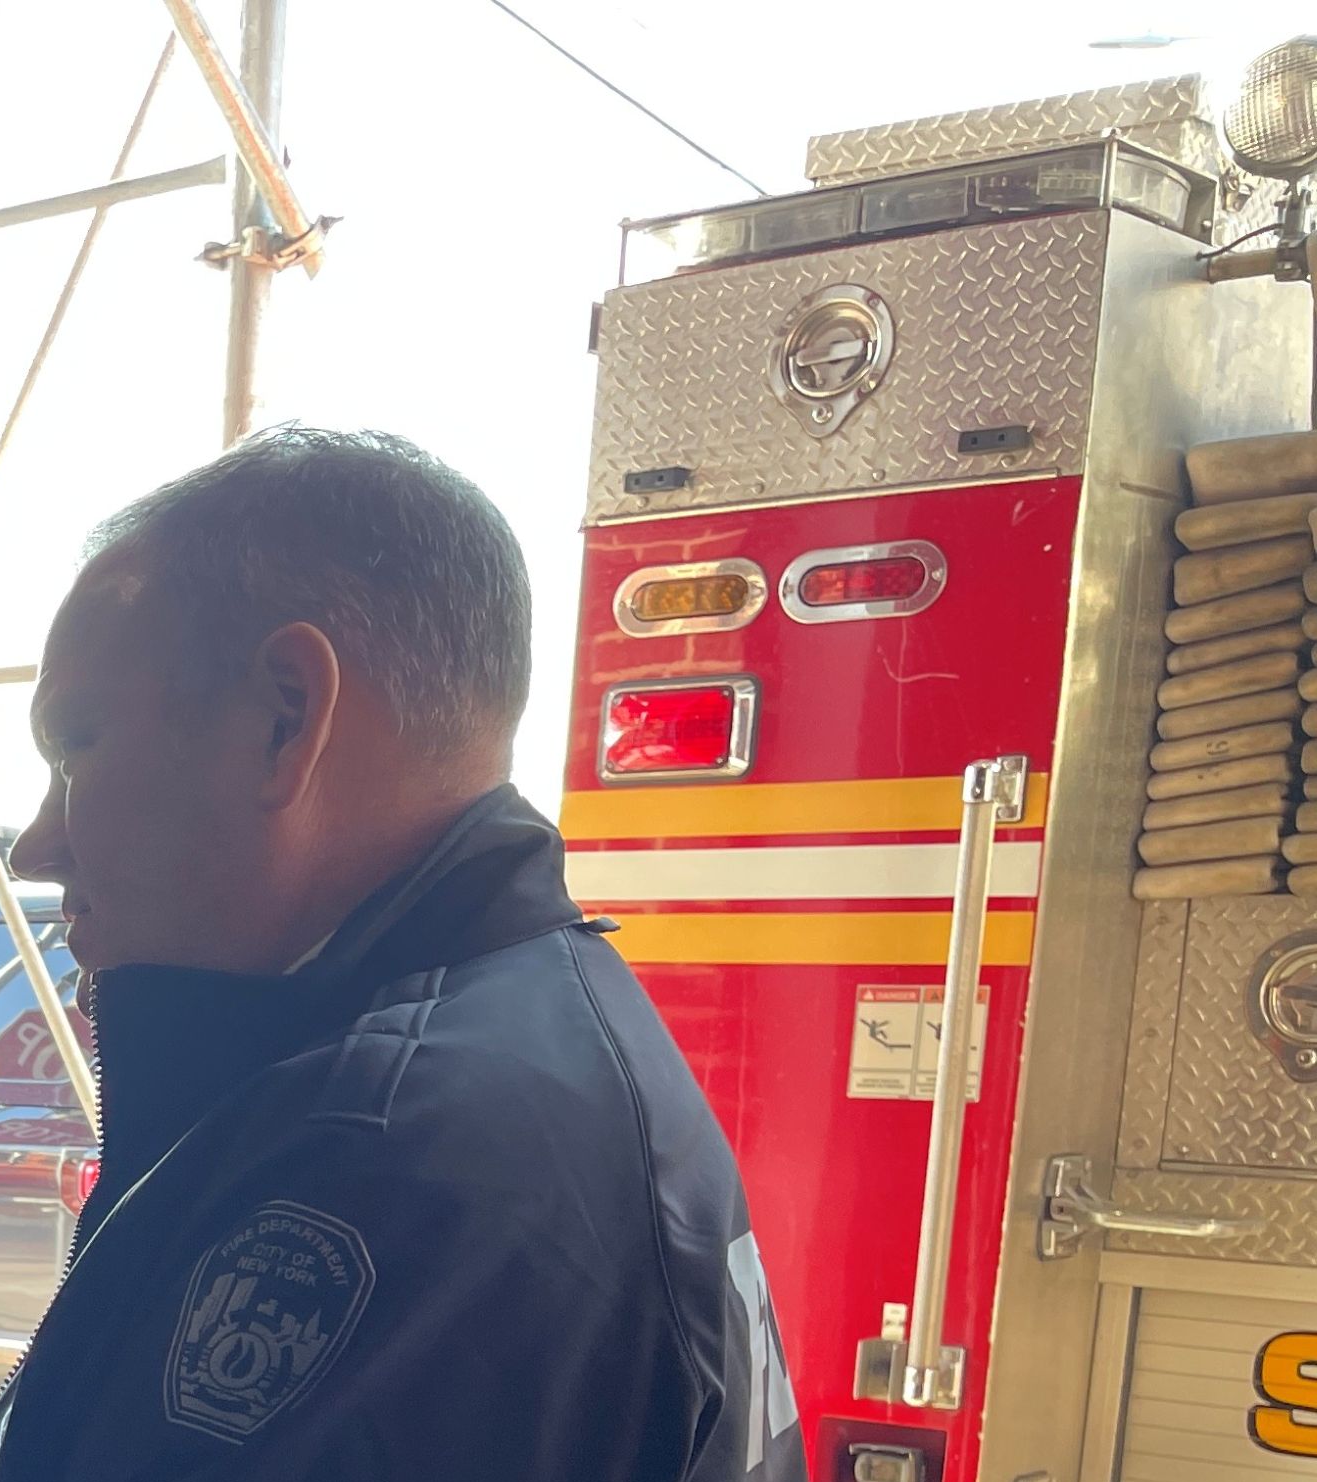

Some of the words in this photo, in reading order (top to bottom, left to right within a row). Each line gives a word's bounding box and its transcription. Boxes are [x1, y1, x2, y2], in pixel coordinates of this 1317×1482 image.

[220, 1228, 255, 1257] FIRE
[258, 1218, 349, 1286] DEPARTMENT
[252, 1242, 288, 1261] CITY
[292, 1252, 317, 1268] OF
[236, 1255, 271, 1274] NEW
[276, 1265, 319, 1288] YORK
